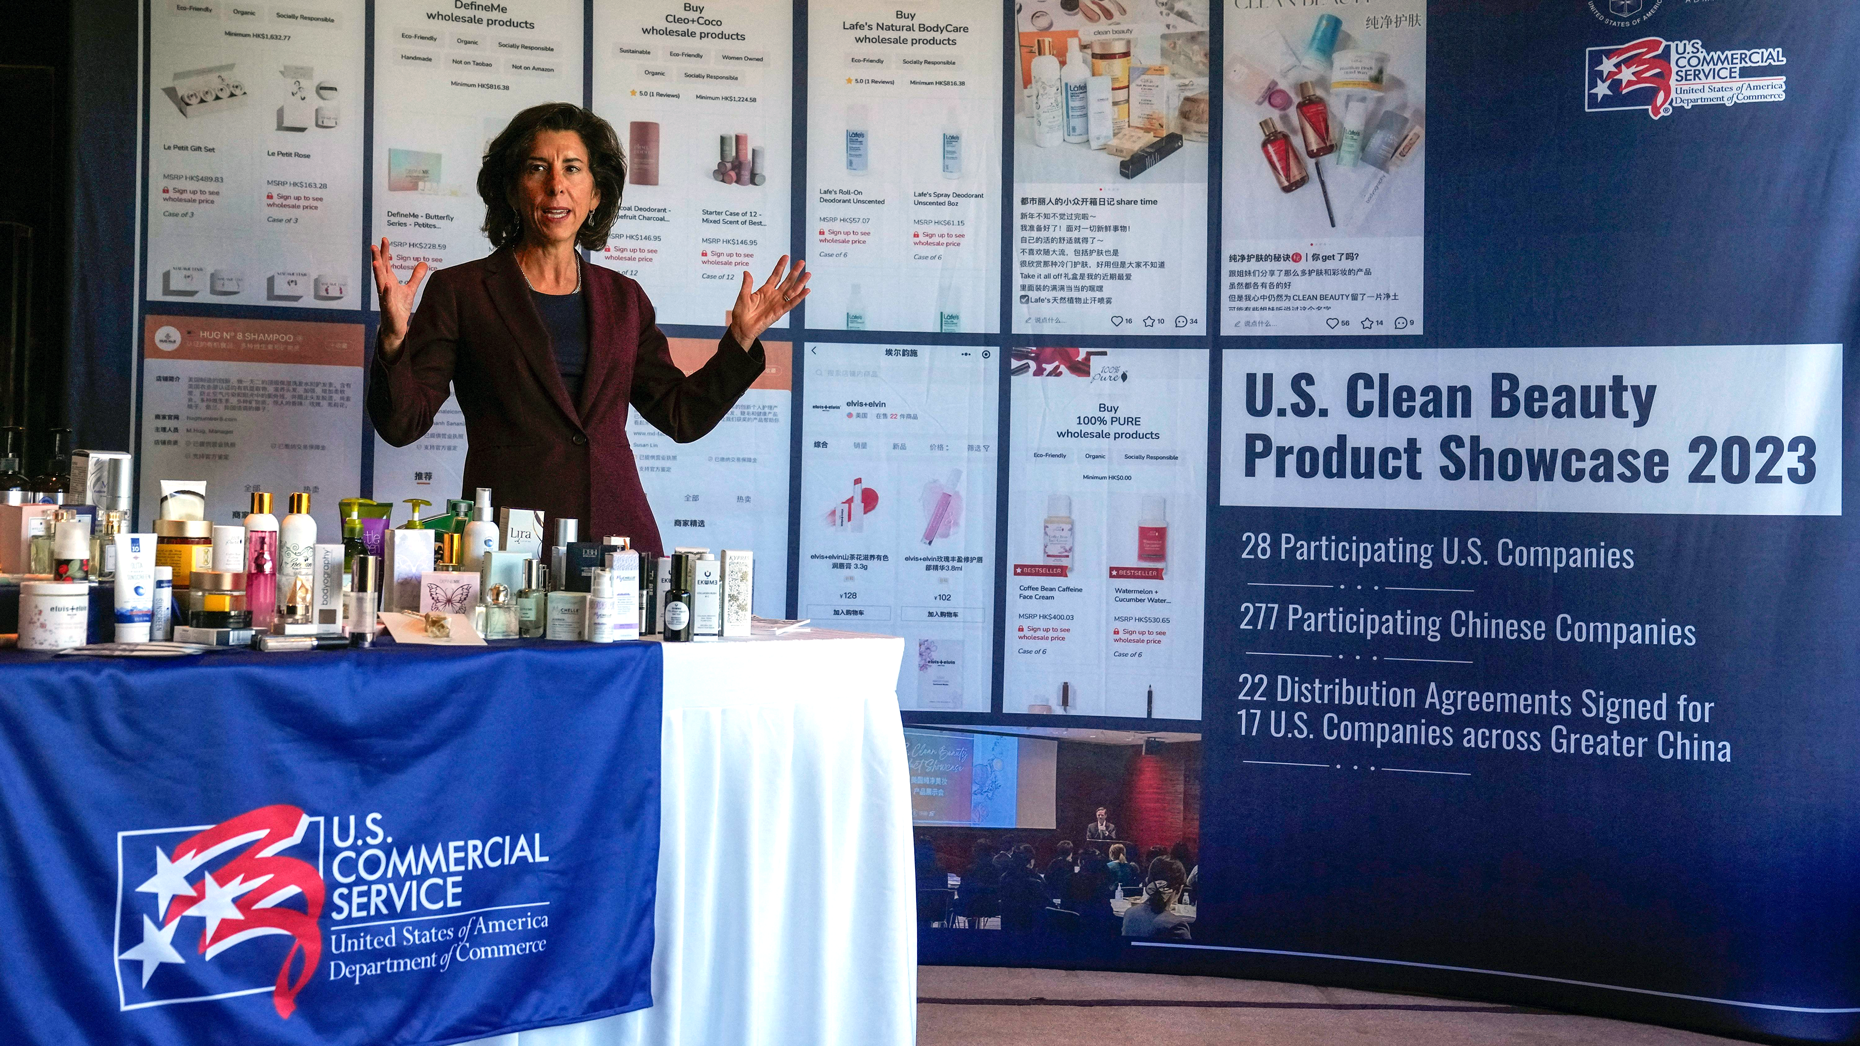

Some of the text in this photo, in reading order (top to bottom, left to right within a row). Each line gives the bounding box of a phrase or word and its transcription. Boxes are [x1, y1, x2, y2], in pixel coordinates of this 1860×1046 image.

[176, 5, 213, 14] Eco-Friendly
[455, 0, 508, 13] DefineMe
[684, 3, 704, 14] Buy
[233, 9, 256, 17] Organic
[276, 12, 335, 24] Socially Responsible
[896, 10, 916, 21] Buy
[1587, 1, 1604, 21] UNITED
[1605, 19, 1630, 27] STATES
[426, 11, 535, 30] wholesale products
[665, 14, 723, 27] Cleo+Coco
[1366, 13, 1422, 29] 纯净护肤
[642, 26, 746, 41] wholesale products
[843, 22, 969, 34] Lafe's Natural BodyCare
[1093, 28, 1133, 36] clean beauty
[252, 33, 291, 41] HK$1,632.77
[854, 35, 957, 46] wholesale products
[1675, 41, 1704, 56] U.S.
[401, 54, 432, 62] Handmade
[1675, 50, 1784, 69] COMMERCIAL
[1675, 67, 1738, 82] SERVICE
[478, 83, 510, 91] HK$816.38
[1675, 82, 1783, 94] United States of America
[1674, 92, 1783, 105] Department of Commerce
[172, 144, 188, 152] Petit
[190, 145, 200, 153] Gift
[1020, 198, 1115, 206] 都市丽人的小众开箱日记
[702, 209, 723, 217] Starter
[200, 330, 221, 339] HUG
[237, 332, 243, 340] 8
[245, 332, 294, 342] SHAMPOO
[846, 400, 886, 408] elvis+elvin
[1246, 372, 1657, 427] U.S. Clean Beauty
[1098, 403, 1119, 414] Buy
[1076, 416, 1141, 426] 100% PURE
[1056, 429, 1160, 441] wholesale products
[1244, 432, 1817, 484] Product Showcase 2023
[414, 472, 432, 481] 推荐
[674, 519, 706, 528] 商家精选
[511, 528, 531, 538] Lira
[1240, 531, 1636, 572] 28 Participating U.S. Companies
[322, 549, 331, 605] bodyography
[1240, 602, 1698, 650] 277 Participating Chinese Companies
[1237, 673, 1715, 724] 22 Distribution Agreements Signed for
[1237, 710, 1732, 764] 17 U.S. Companies across Greater China
[332, 812, 392, 847] U.S.
[332, 832, 549, 884] COMMERCIAL
[331, 877, 463, 920] SERVICE
[330, 913, 549, 954] United States of America
[329, 938, 547, 985] Department of Commerce
